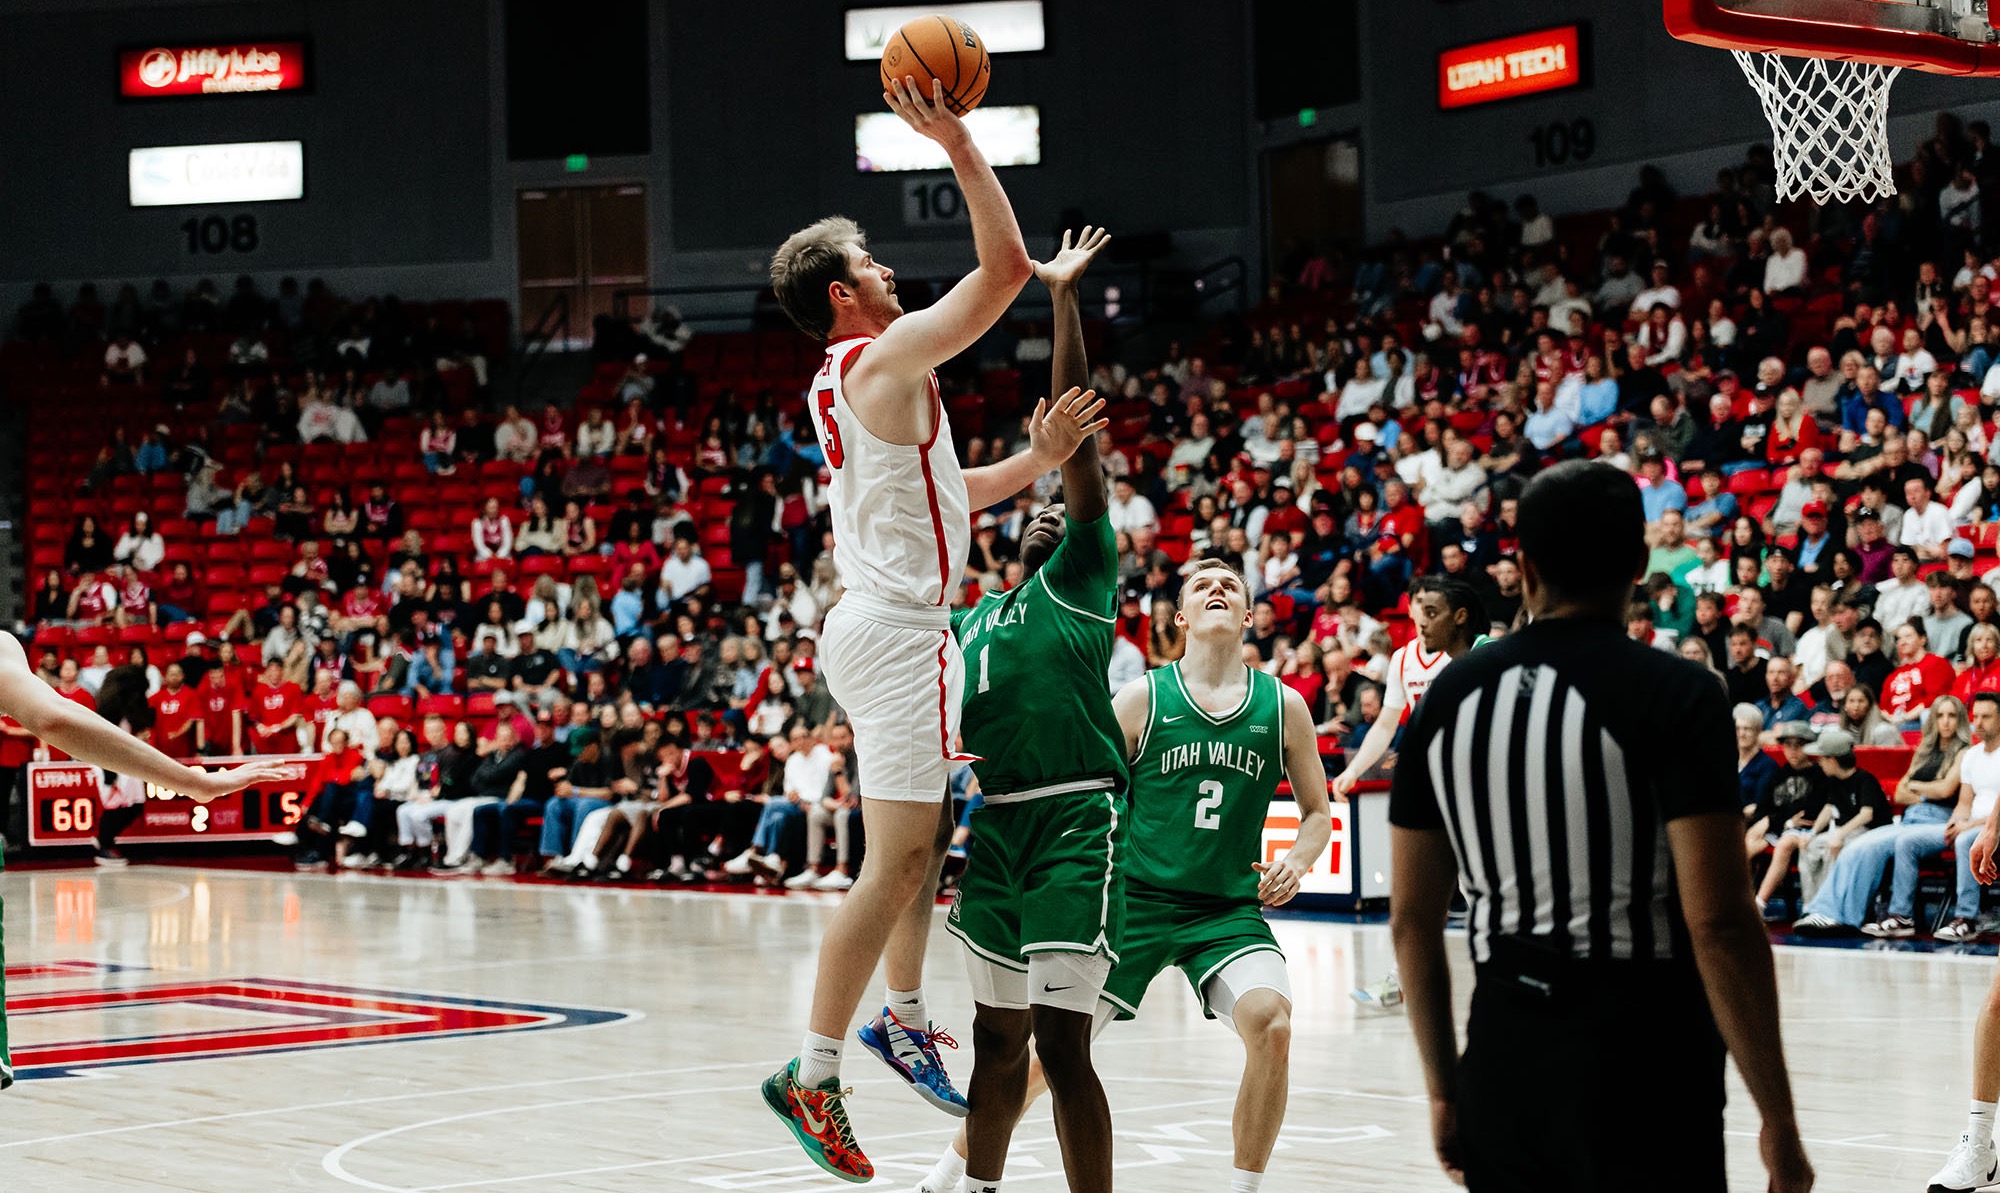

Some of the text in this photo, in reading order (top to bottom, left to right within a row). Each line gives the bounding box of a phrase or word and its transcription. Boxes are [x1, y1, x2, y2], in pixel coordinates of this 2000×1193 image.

[1447, 44, 1567, 91] UTAH TECH
[1529, 115, 1596, 168] 109
[912, 181, 962, 220] 10
[181, 214, 260, 254] 108
[978, 644, 990, 694] 1
[35, 770, 82, 789] UTAH
[1161, 741, 1265, 781] UTAH VALLEY
[53, 798, 93, 831] 60
[191, 805, 209, 832] 2
[1194, 779, 1224, 830] 2
[883, 1014, 930, 1069] NIKE
